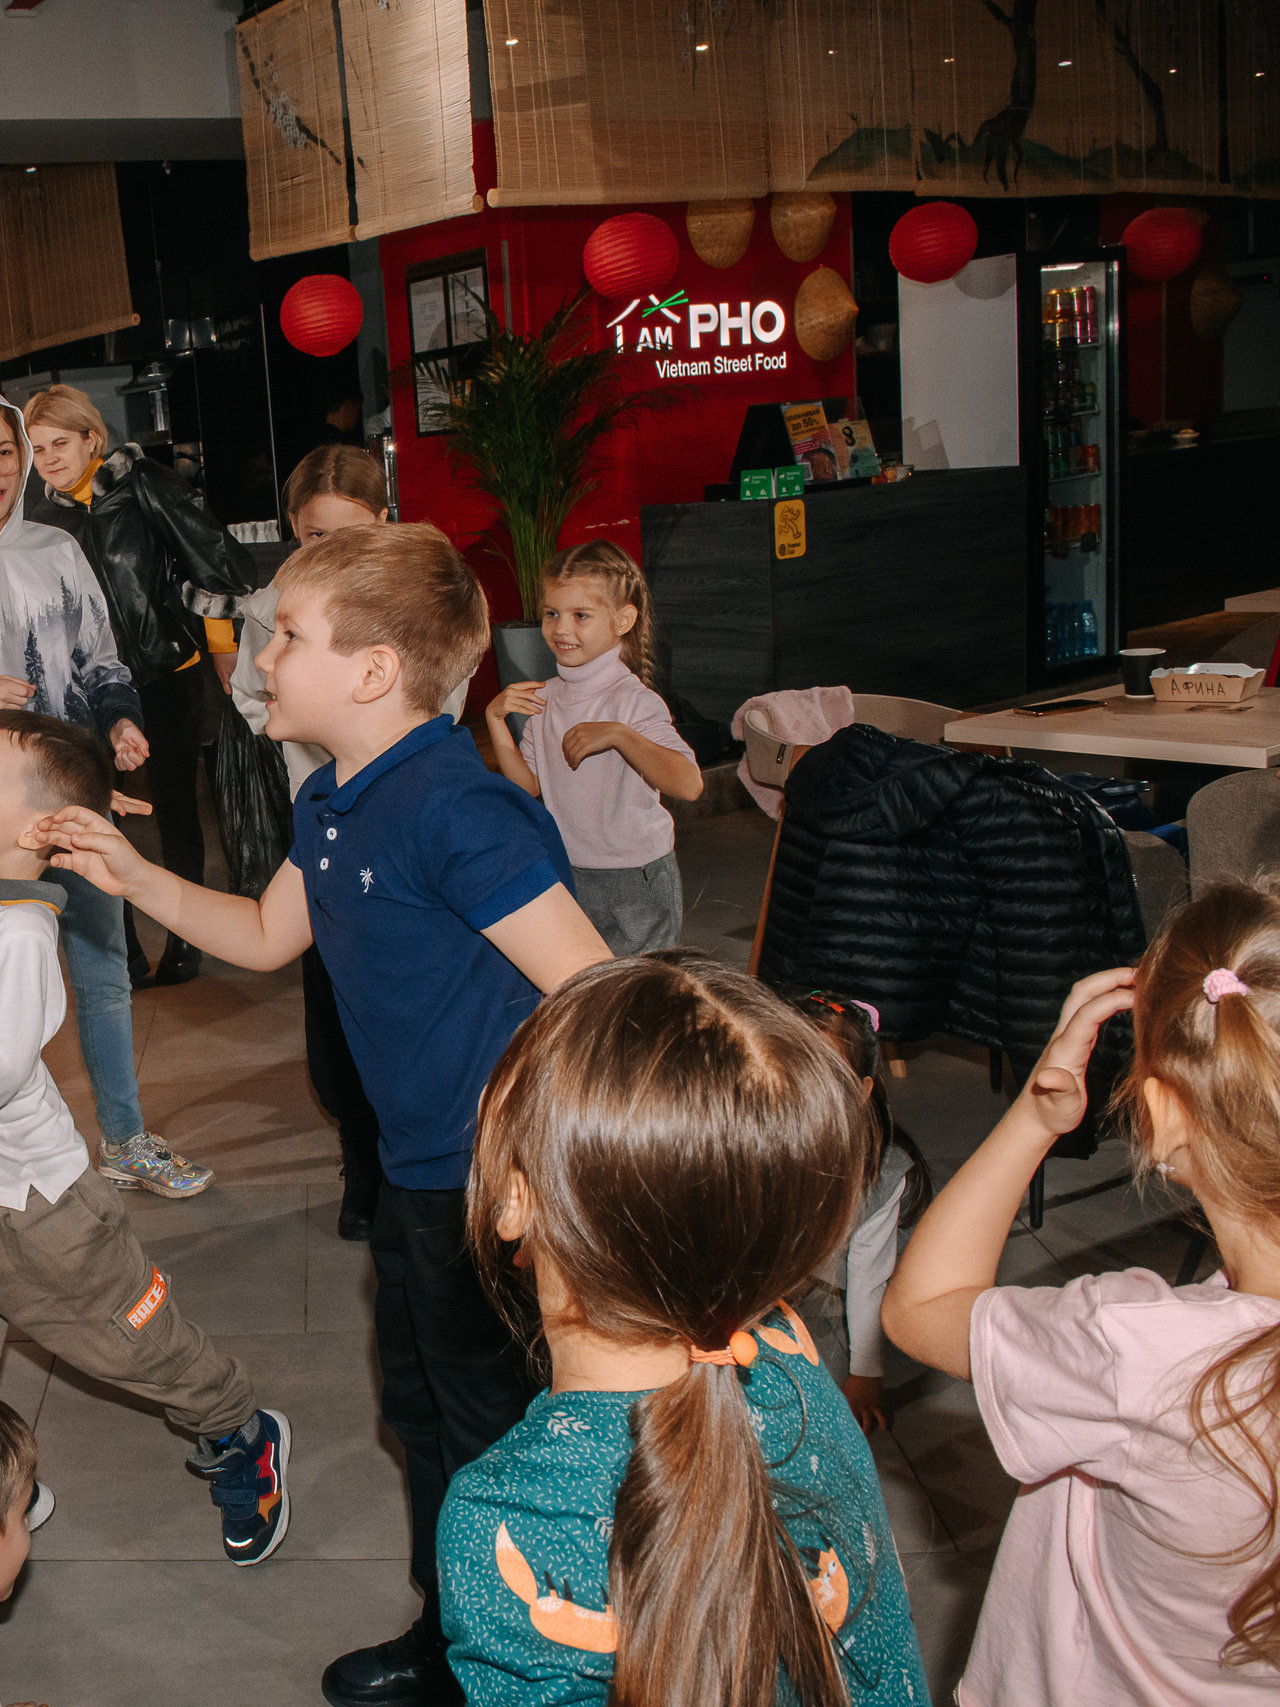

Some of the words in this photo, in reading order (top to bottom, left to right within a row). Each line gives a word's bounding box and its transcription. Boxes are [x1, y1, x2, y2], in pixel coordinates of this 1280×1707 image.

[636, 326, 673, 352] AM
[689, 300, 786, 348] PHO
[655, 360, 711, 378] Vietnam
[714, 356, 752, 374] Street
[755, 351, 787, 371] Food
[1171, 678, 1226, 696] АФИНА
[128, 1283, 164, 1328] RACE
